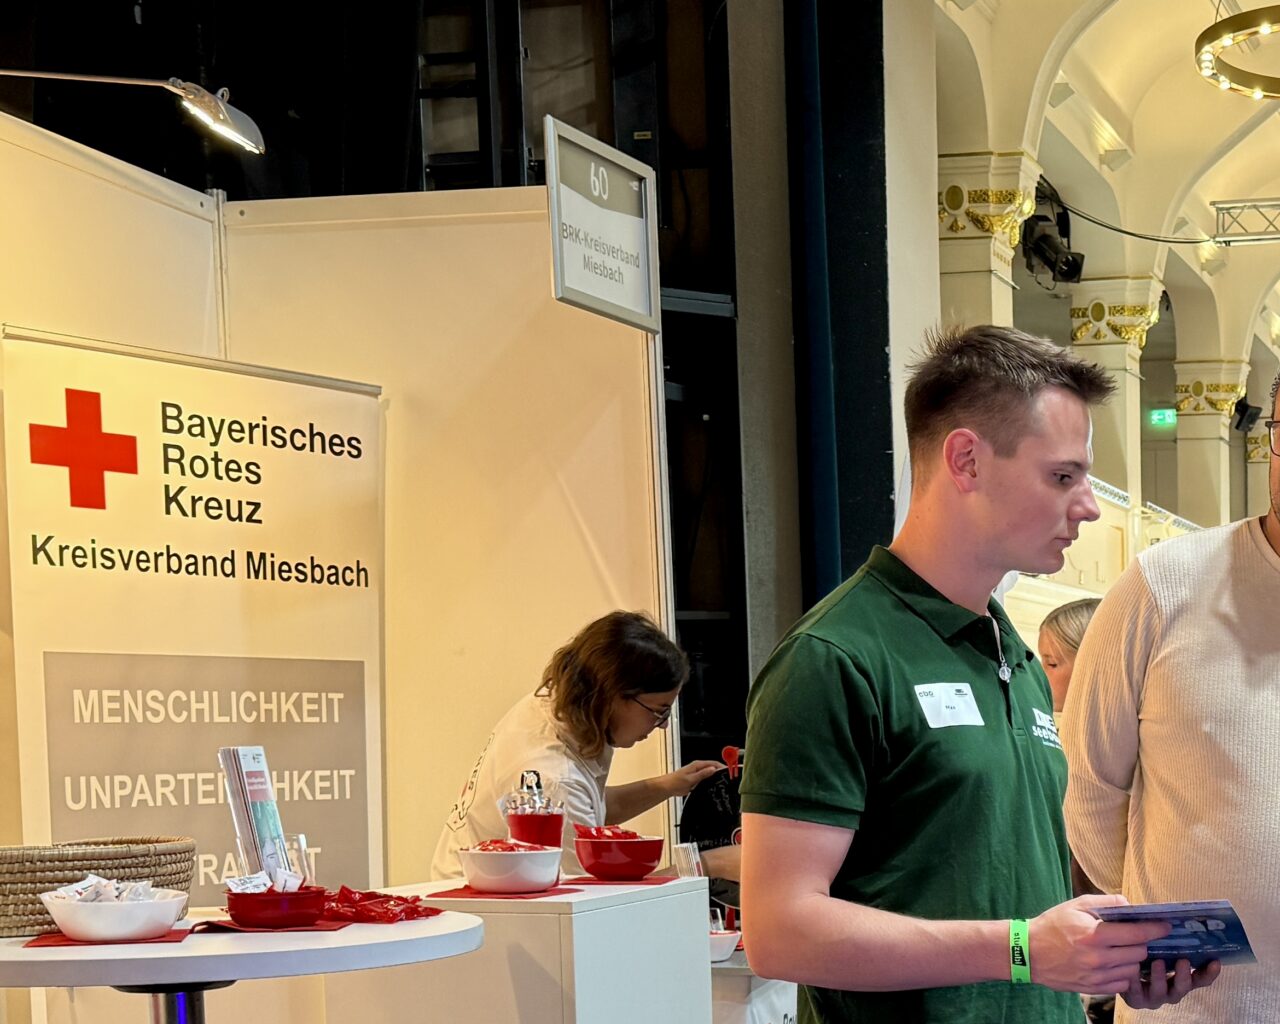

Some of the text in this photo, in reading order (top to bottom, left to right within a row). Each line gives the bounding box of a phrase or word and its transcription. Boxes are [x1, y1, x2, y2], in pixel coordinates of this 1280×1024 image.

[590, 162, 608, 201] 60
[561, 222, 640, 269] BRK-Kreisverband
[582, 254, 624, 285] Miesbach
[160, 401, 363, 460] Bayerisches
[162, 443, 263, 486] Rotes
[163, 483, 264, 525] Kreuz
[30, 533, 370, 588] Kreisverband Miesbach
[72, 688, 345, 725] MENSCHLICHKEIT
[64, 769, 356, 812] UNPARTEIHKEIT
